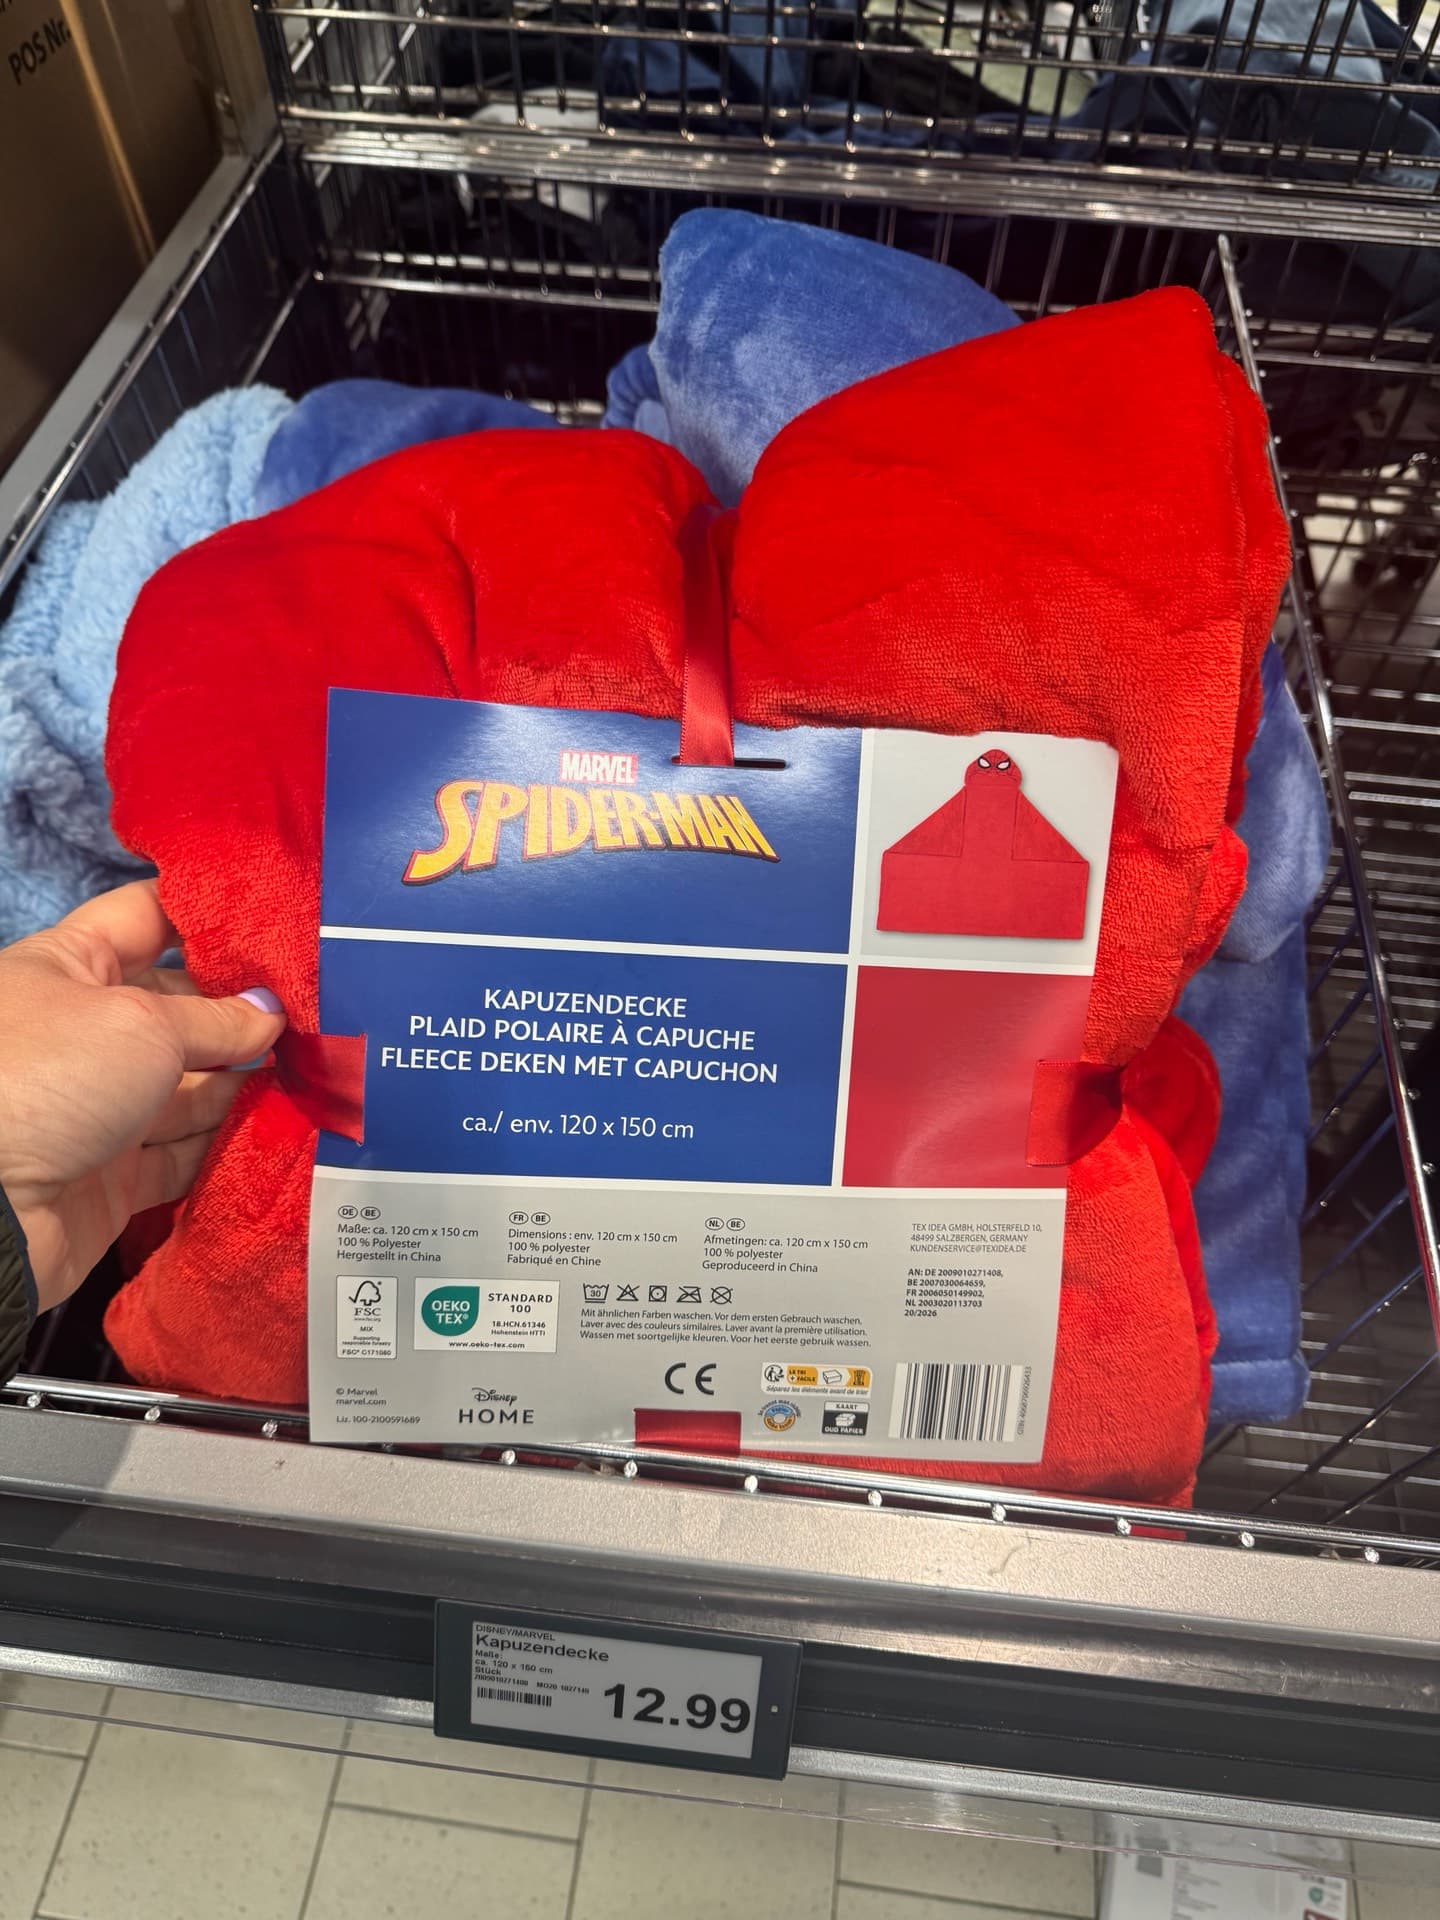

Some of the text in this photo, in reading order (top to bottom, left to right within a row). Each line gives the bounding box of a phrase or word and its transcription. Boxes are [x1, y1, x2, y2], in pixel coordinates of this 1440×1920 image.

[8, 31, 46, 86] POS
[562, 752, 637, 784] MARVEL
[402, 780, 780, 885] SPIDER-MAN
[484, 988, 687, 1018] KAPUZENDECKE
[410, 1015, 755, 1051] PLAID POLAIRE À CAPUCHE
[381, 1046, 778, 1084] FLEECE DEKEN MET CAPUCHON
[462, 1111, 694, 1139] ca./ env. 120 x 150 cm
[342, 1208, 377, 1217] DE BE
[513, 1214, 524, 1222] FR
[708, 1220, 720, 1228] NL
[912, 1223, 1042, 1233] TEX IDEA GMBH, HOLSTERFELD 10,
[337, 1223, 370, 1235] Maße:
[373, 1226, 388, 1235] ca.
[391, 1225, 410, 1236] 120
[412, 1228, 429, 1236] cm
[441, 1227, 460, 1237] 150
[462, 1229, 479, 1238] cm
[508, 1228, 567, 1240] Dimensions
[574, 1233, 594, 1241] env.
[597, 1231, 615, 1241] 120
[617, 1234, 632, 1242] cm
[644, 1232, 660, 1242] 150
[662, 1234, 678, 1243] cm
[338, 1237, 421, 1250] 100 % Polyester
[704, 1234, 767, 1247] Afmetingen:
[769, 1238, 783, 1247] ca.
[786, 1237, 804, 1247] 120
[833, 1238, 850, 1248] 150
[853, 1241, 868, 1249] cm
[910, 1234, 1028, 1243] 48499 SALZBERGEN, GERMANY
[508, 1242, 590, 1254] 100 % polyester
[704, 1247, 783, 1260] 100 % polyester
[910, 1244, 1027, 1253] KUNDENSERVICE@TEXIDEA.DE
[337, 1249, 441, 1262] Hergestellt in China
[507, 1254, 602, 1266] Fabriqué en Chine
[702, 1260, 818, 1273] Geproduceerd in China
[908, 1268, 923, 1277] AN:
[924, 1268, 936, 1277] DE
[907, 1279, 918, 1287] BE
[488, 1292, 553, 1303] STANDARD
[590, 1289, 601, 1297] 30
[906, 1289, 917, 1297] FR
[431, 1300, 471, 1312] OEKO
[510, 1304, 531, 1313] 100
[905, 1299, 982, 1308] NL 2003020113703
[354, 1307, 382, 1317] FSC
[581, 1308, 862, 1325] Mit ähnlichen Farben waschen. Vor dem ersten Gebrauch waschen.
[904, 1309, 937, 1317] 20/2026
[580, 1320, 604, 1328] Laver
[627, 1320, 642, 1329] des
[644, 1321, 681, 1330] couleurs
[682, 1322, 724, 1331] similaires.
[725, 1323, 748, 1333] Laver
[750, 1325, 773, 1333] avant
[775, 1325, 783, 1334] la
[784, 1325, 823, 1335] première
[824, 1326, 867, 1336] utilisation.
[580, 1330, 871, 1347] Wassen met soortgelijke kleuren. Voor het eerste gebruik wassen.
[449, 1341, 525, 1349] www.oeko-tex.com
[665, 1362, 717, 1395] CE
[347, 1388, 377, 1397] Marvel
[336, 1397, 387, 1406] marvel.com
[336, 1415, 350, 1423] Liz.
[459, 1408, 535, 1424] HOME
[475, 1624, 556, 1641] DISNEY/MARVEL
[476, 1634, 609, 1661] Kapuzendecke
[475, 1666, 502, 1675] Stück
[493, 1660, 508, 1668] 120
[521, 1663, 536, 1672] 150
[604, 1683, 751, 1733] 12.99
